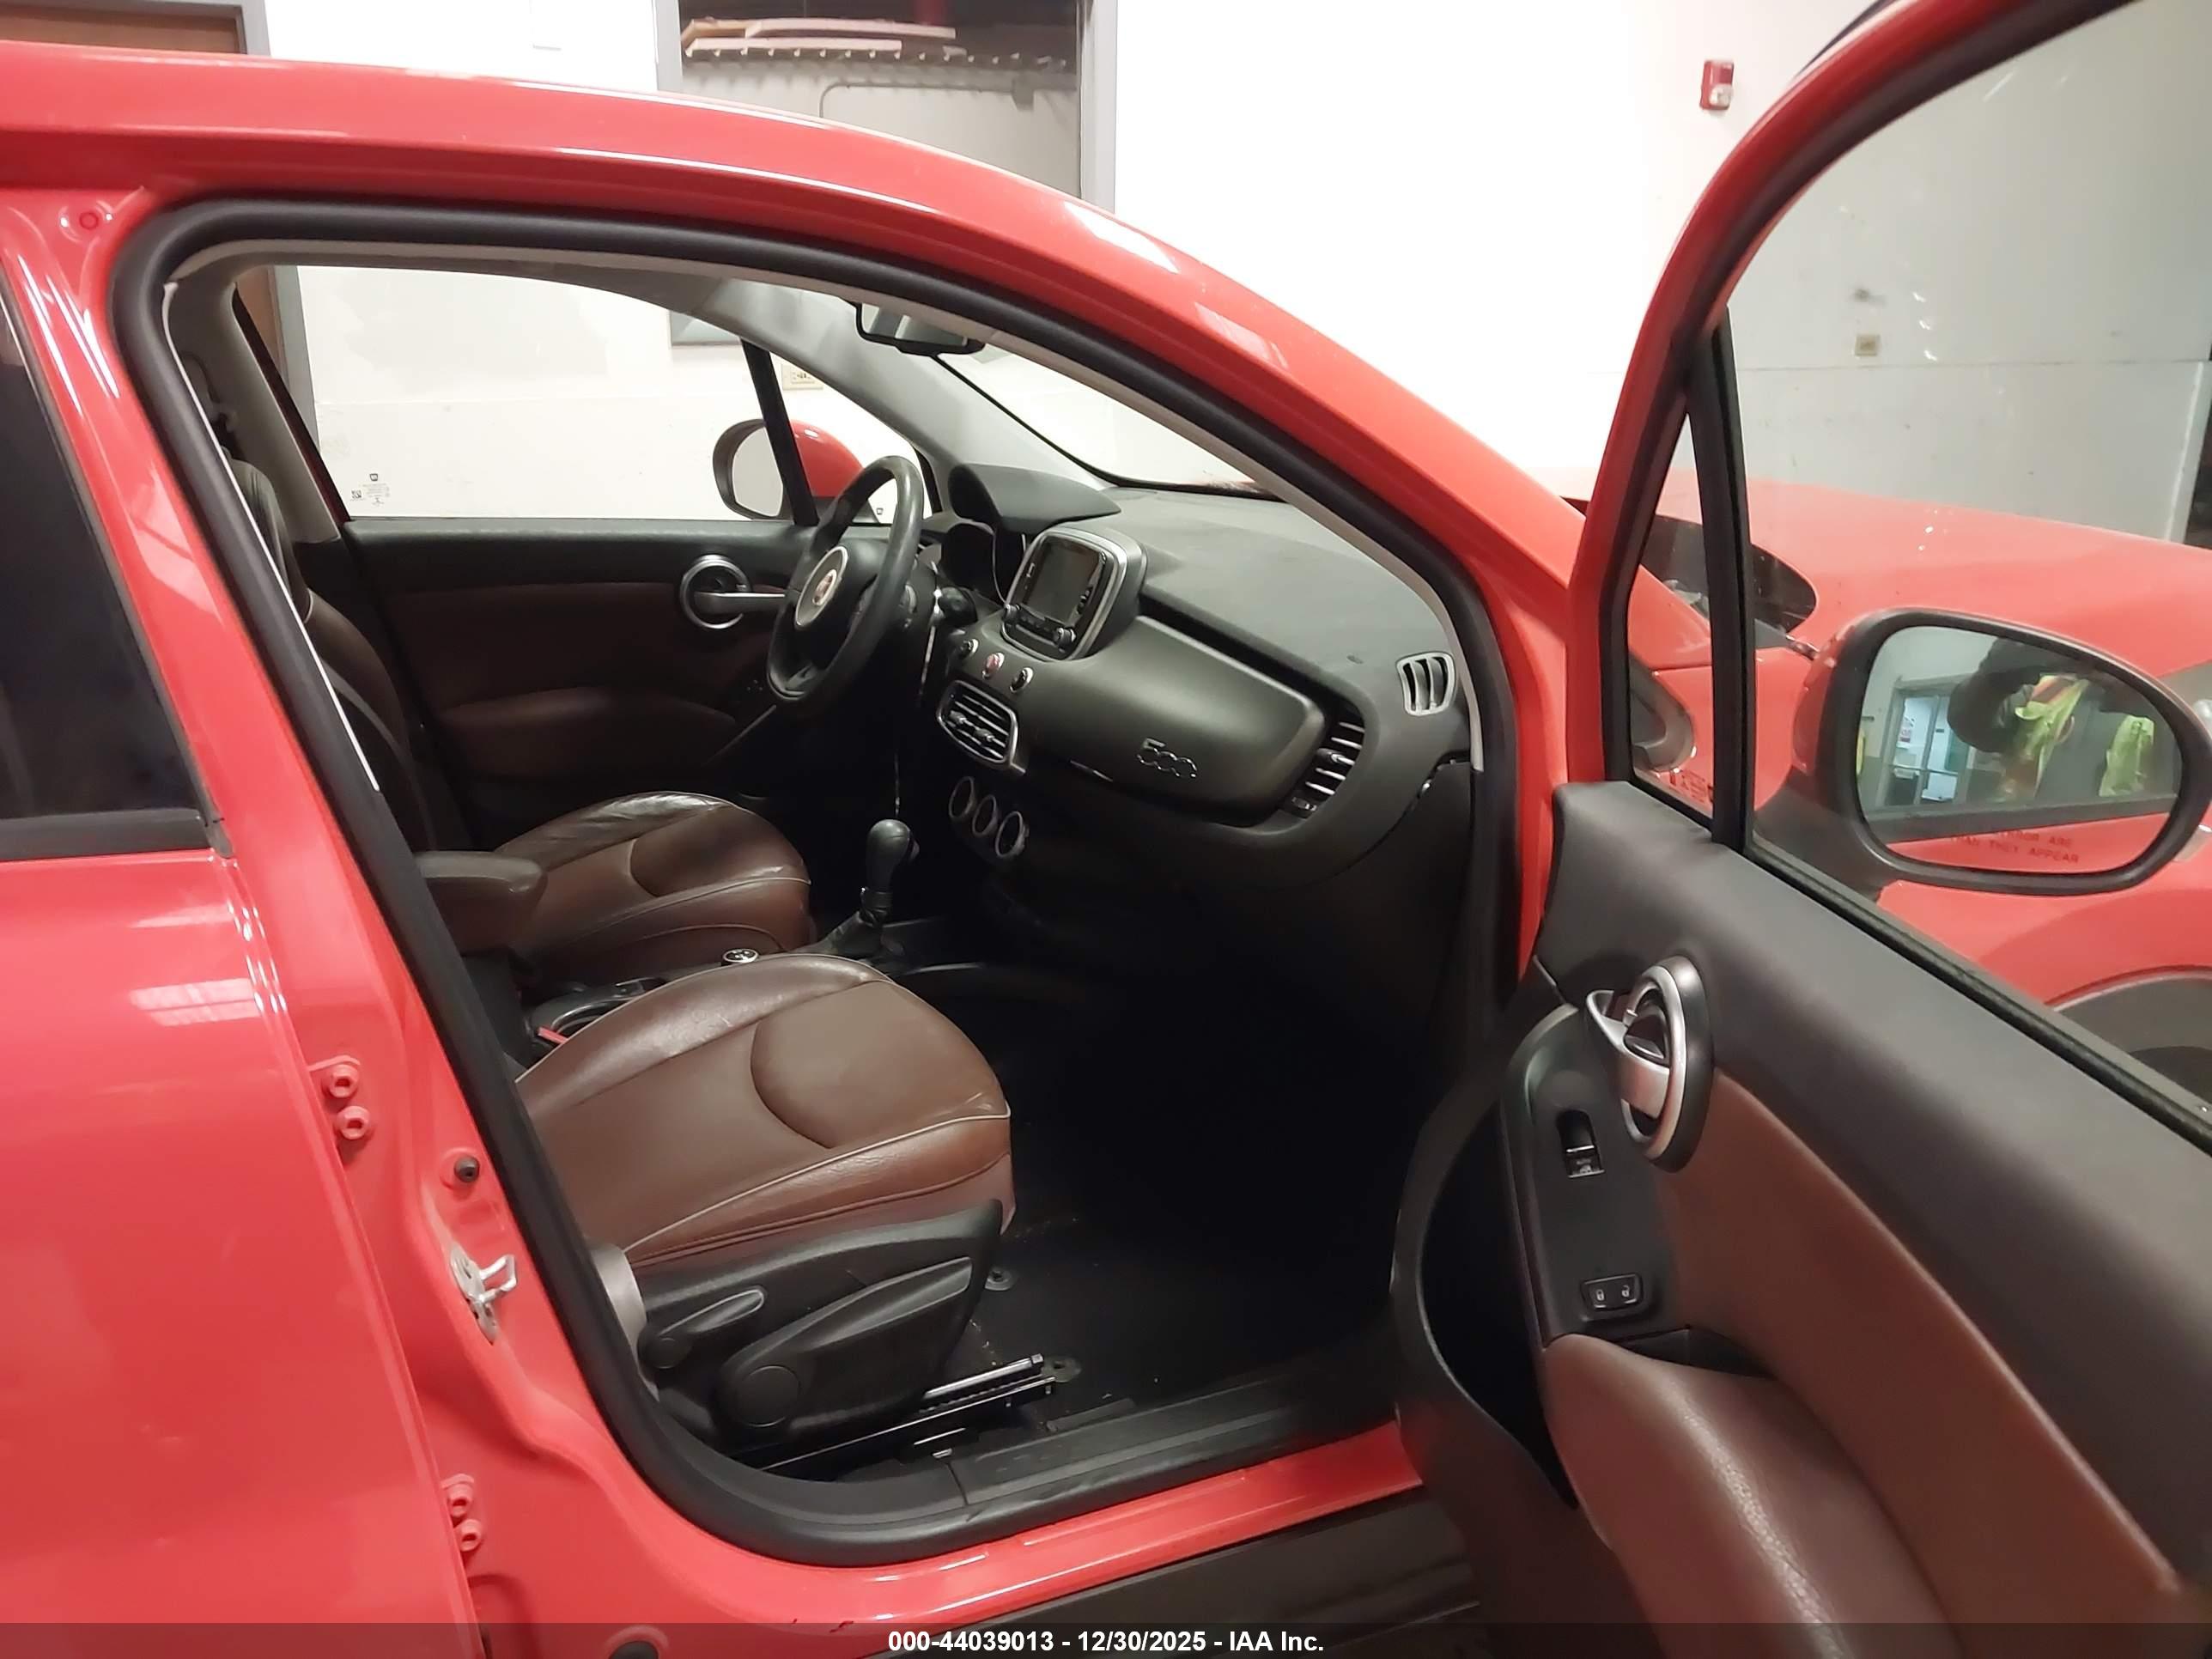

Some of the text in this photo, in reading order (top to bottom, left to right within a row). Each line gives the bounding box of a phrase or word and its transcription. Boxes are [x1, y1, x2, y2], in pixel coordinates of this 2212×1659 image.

[1137, 738, 1198, 778] 500
[2049, 836, 2073, 848] ARE
[2029, 847, 2080, 863] APPEAR
